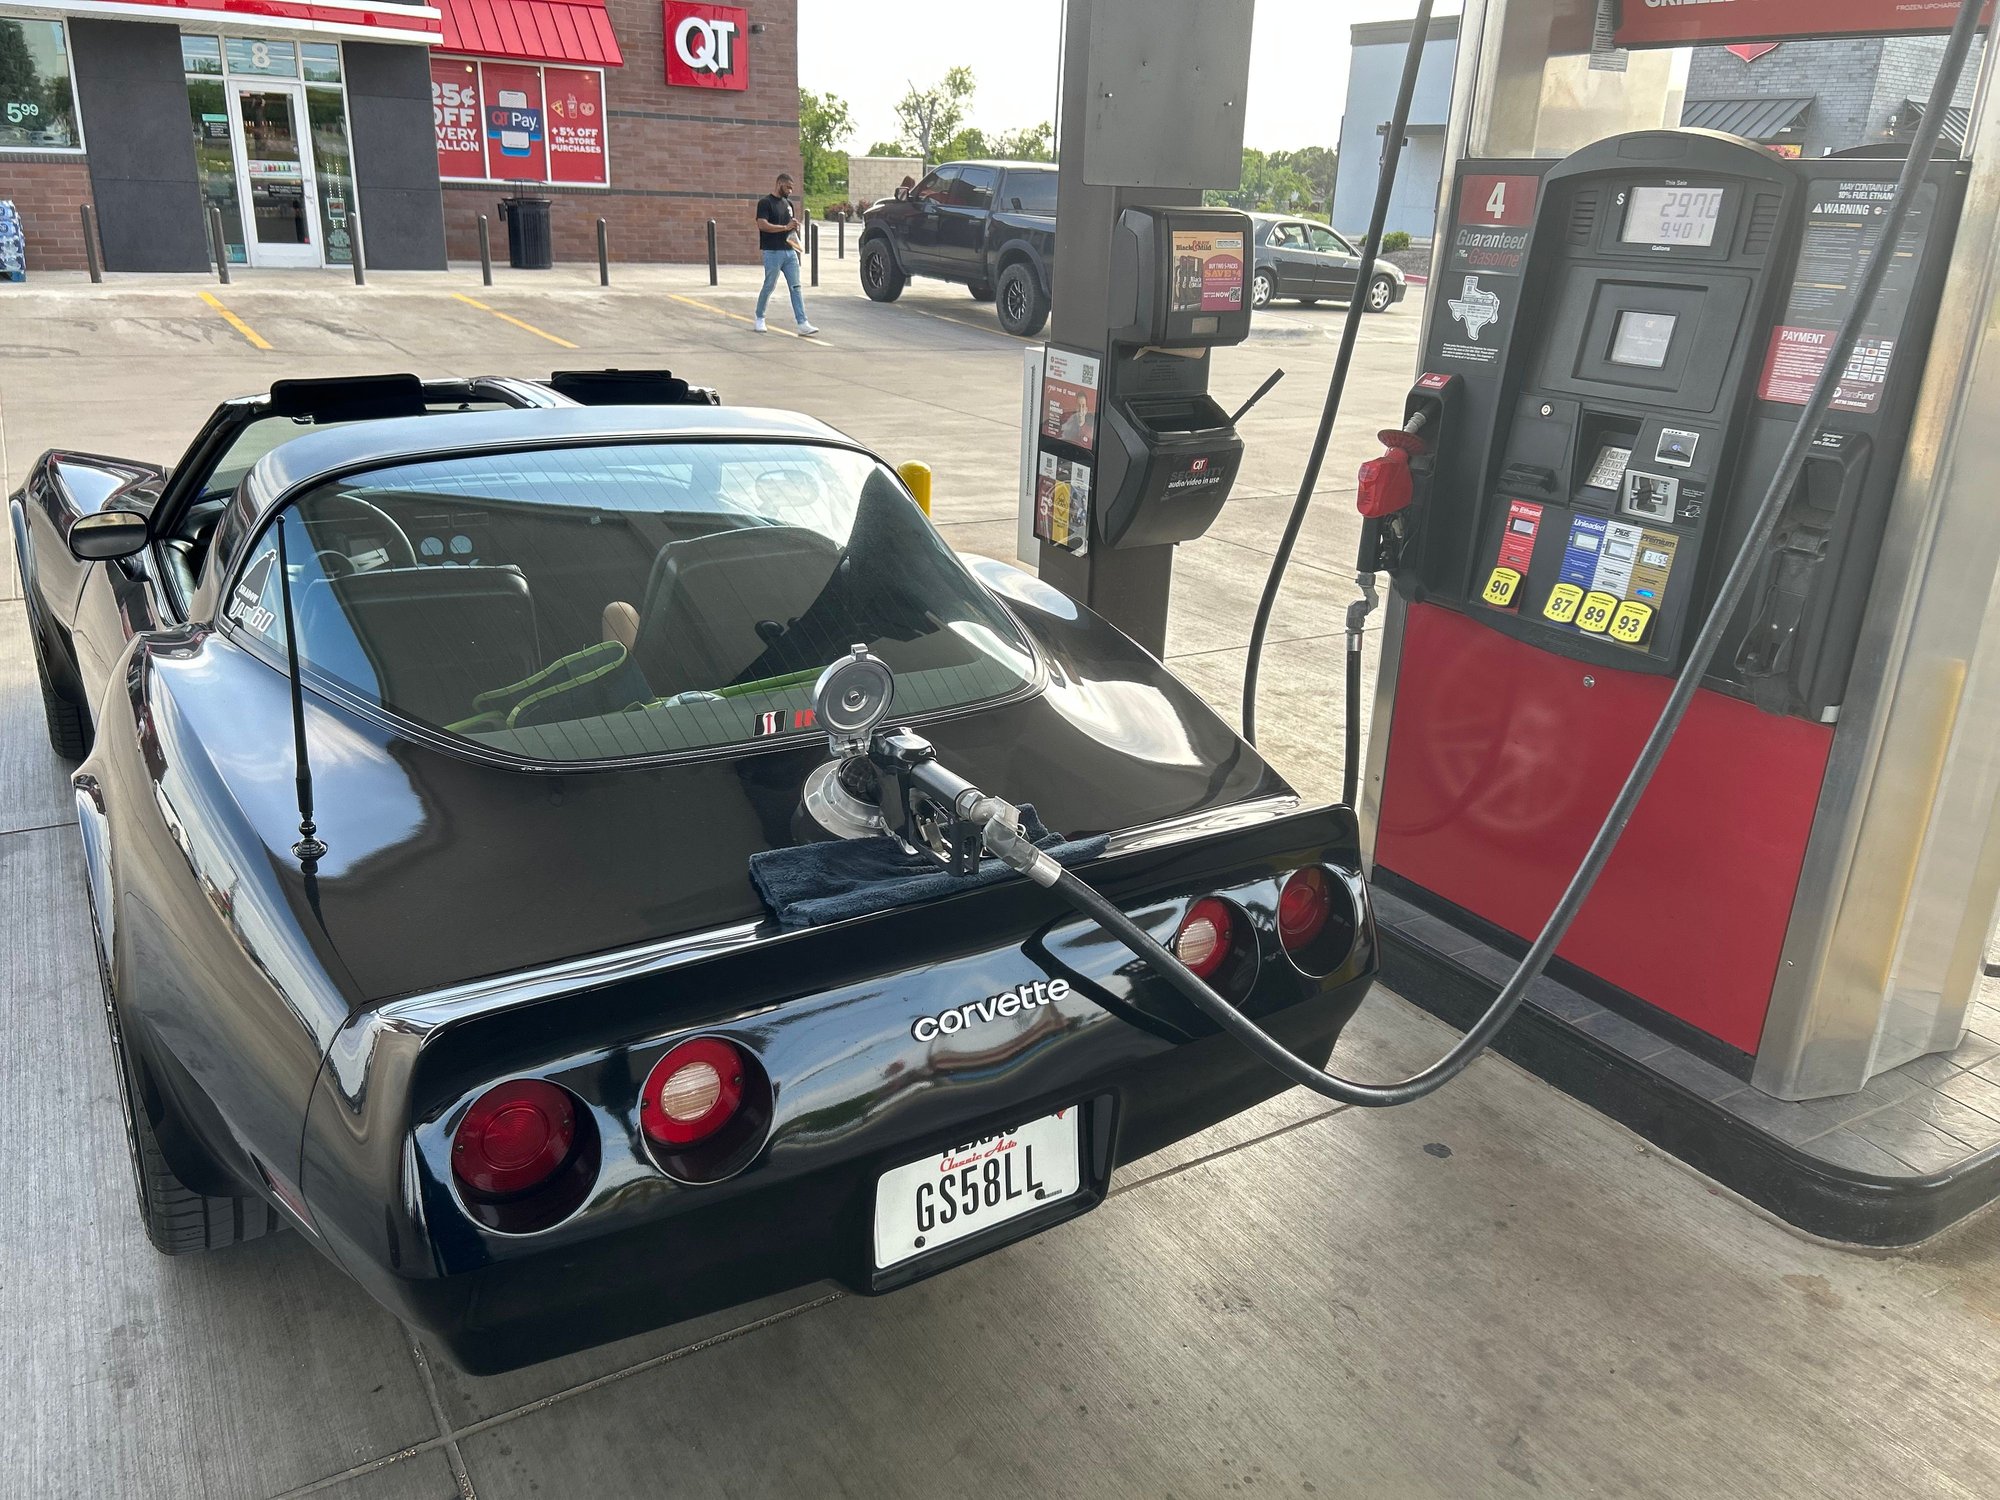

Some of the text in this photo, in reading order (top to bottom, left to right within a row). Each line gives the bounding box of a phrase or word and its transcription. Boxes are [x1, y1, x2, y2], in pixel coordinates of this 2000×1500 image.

[675, 16, 736, 74] QT
[251, 42, 271, 69] 8
[492, 111, 510, 126] QT
[436, 127, 478, 140] VERY
[559, 128, 575, 137] 5%
[577, 128, 599, 138] OFF
[436, 140, 480, 152] ALLON
[555, 137, 596, 146] IN-STORE
[551, 144, 601, 154] PURCHASES
[1485, 182, 1506, 219] 4
[1616, 192, 1625, 205] $
[1868, 192, 1895, 200] ETHAN
[1823, 203, 1870, 215] WARNING
[1457, 229, 1529, 250] Guaranteed
[1204, 269, 1232, 277] SAVE
[1781, 330, 1826, 344] PAYMENT
[1193, 459, 1206, 471] QT
[1209, 476, 1220, 484] use
[1574, 519, 1606, 532] Unleaded
[1641, 533, 1675, 548] Premium
[1491, 579, 1509, 596] 90
[1551, 597, 1573, 614] 87
[1584, 606, 1606, 623] 89
[1618, 615, 1640, 633] 93
[914, 978, 1070, 1042] corvette
[940, 1153, 983, 1173] Classic
[984, 1139, 1018, 1158] Auto
[916, 1144, 1043, 1233] GS58LL
